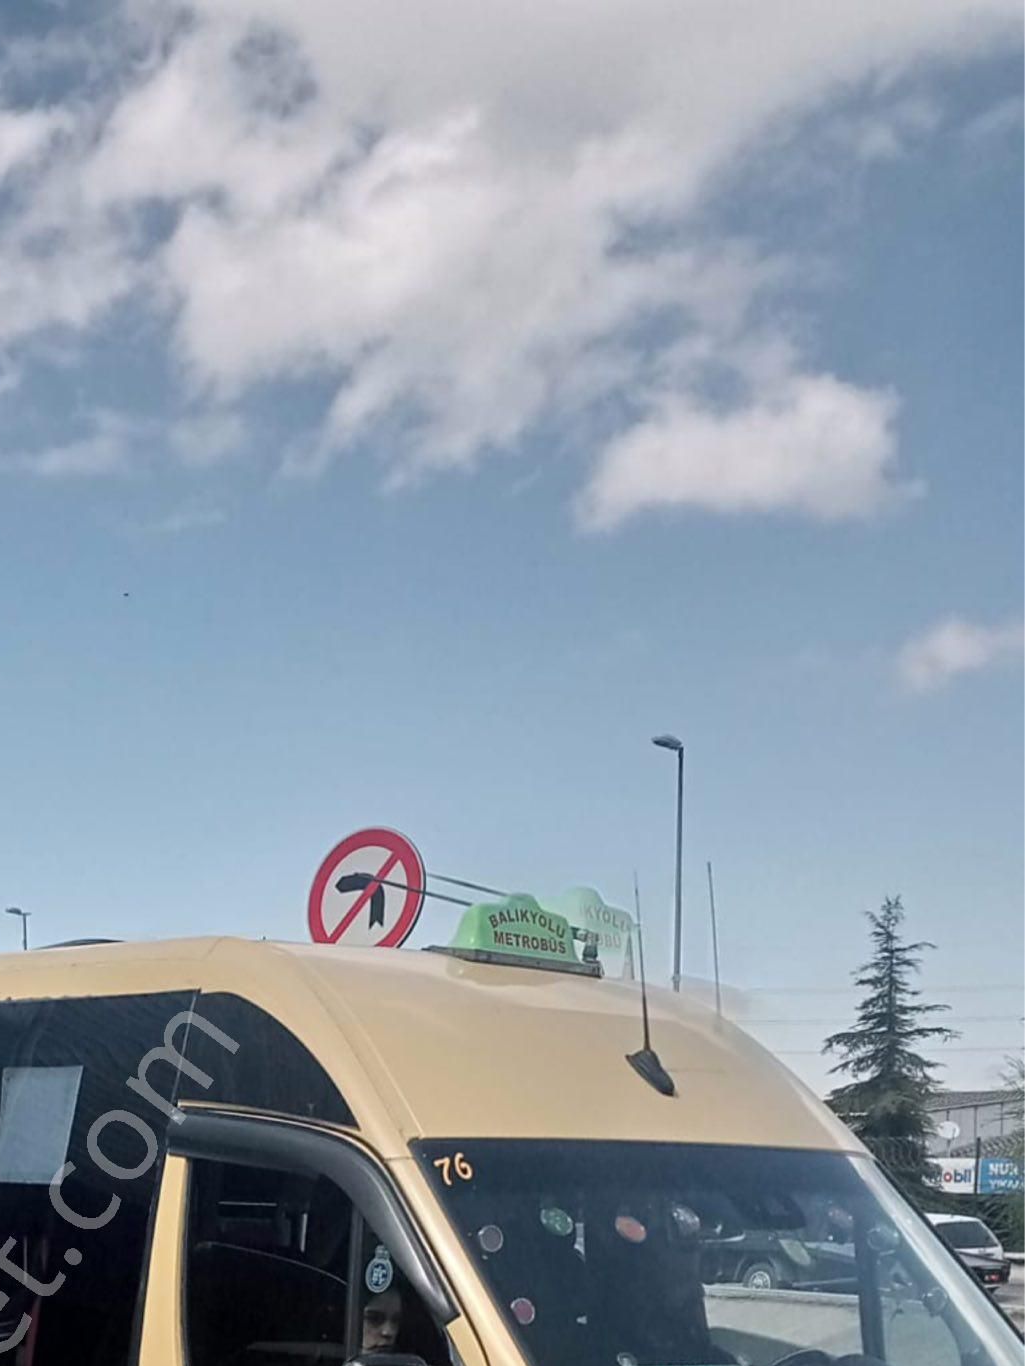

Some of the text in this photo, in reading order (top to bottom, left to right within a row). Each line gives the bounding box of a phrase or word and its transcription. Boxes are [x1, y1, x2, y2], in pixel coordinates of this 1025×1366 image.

[488, 909, 566, 939] BALIKYOLU
[494, 930, 567, 954] METROBÜS
[434, 1153, 473, 1186] 76
